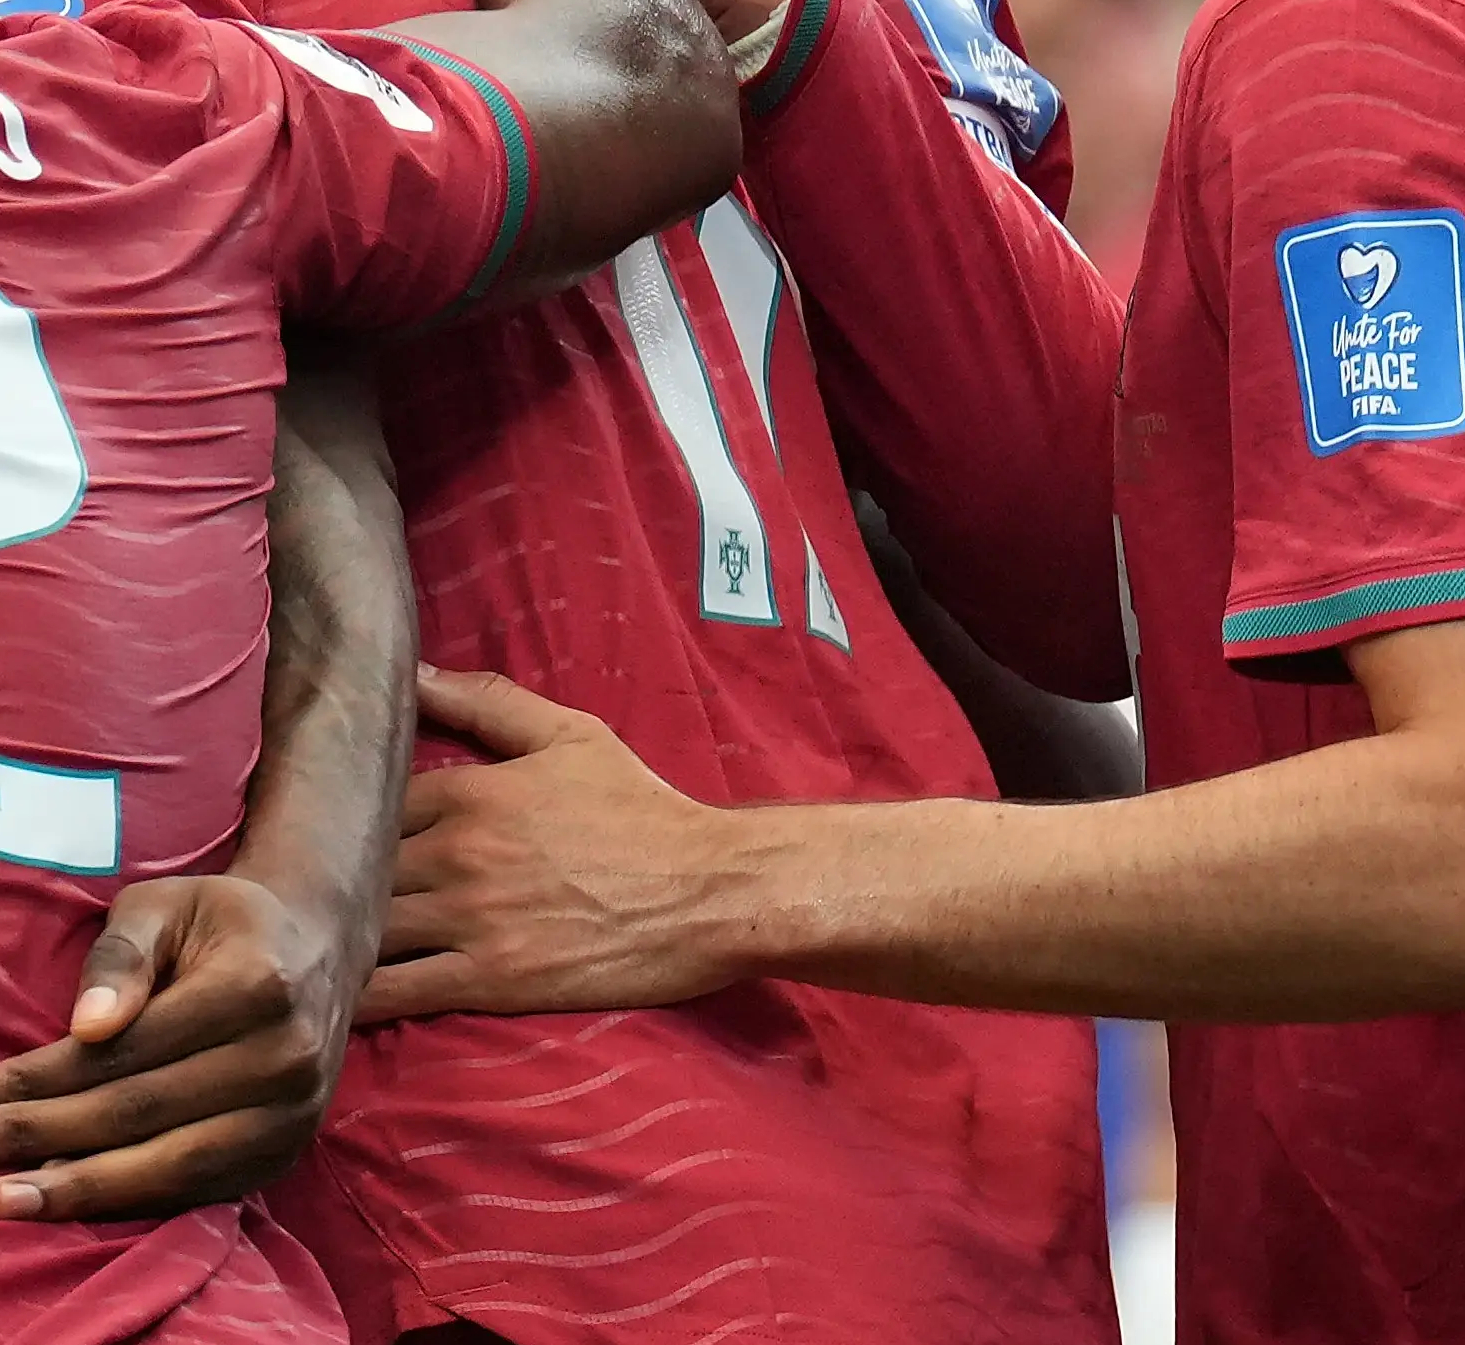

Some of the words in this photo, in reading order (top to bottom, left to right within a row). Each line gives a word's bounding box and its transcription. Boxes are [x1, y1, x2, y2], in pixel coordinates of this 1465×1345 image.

[1332, 312, 1383, 358] Unite
[1382, 311, 1422, 350] For
[1339, 352, 1418, 398] PEACE
[1352, 395, 1397, 419] FIFA
